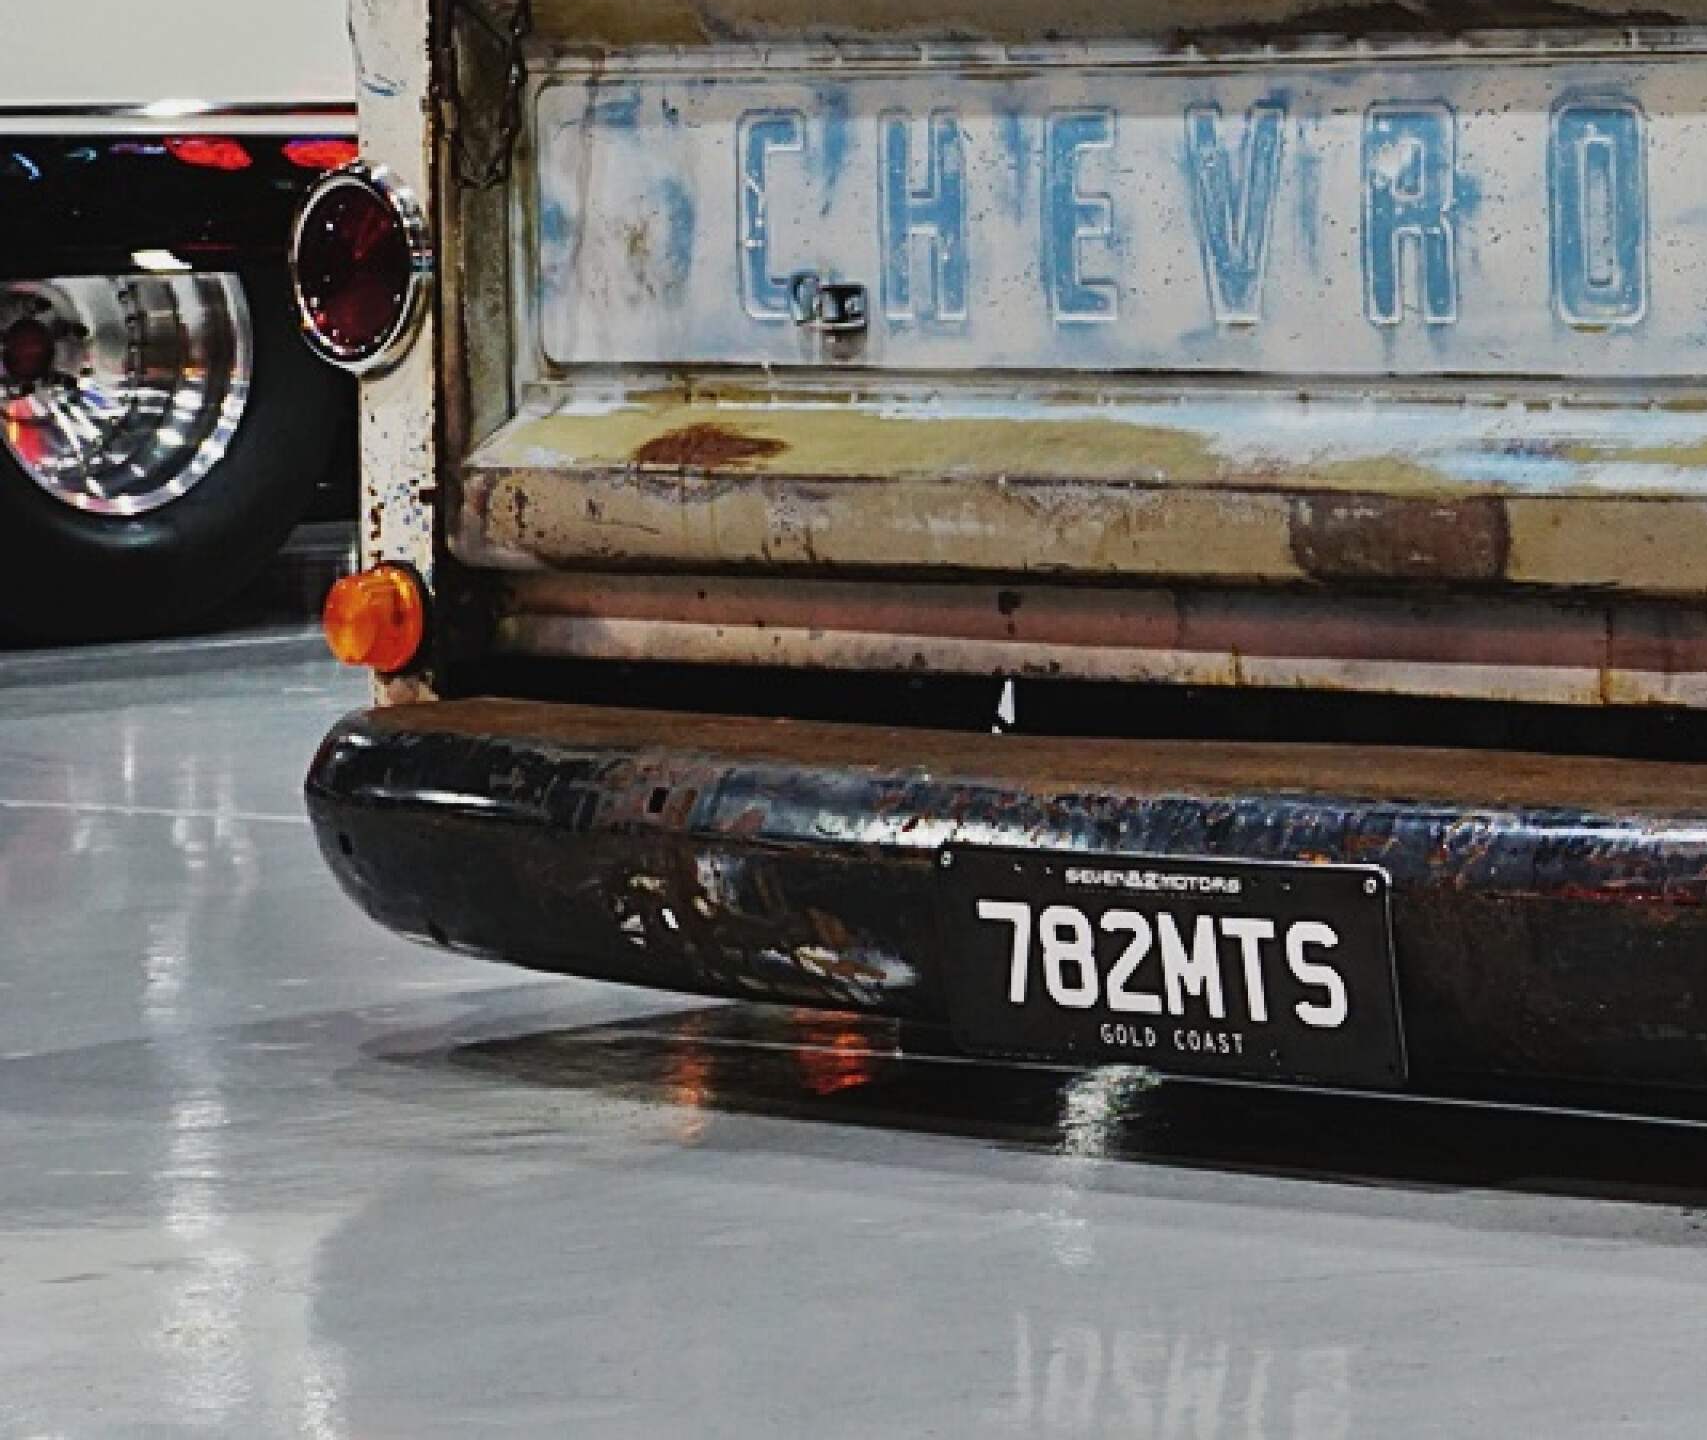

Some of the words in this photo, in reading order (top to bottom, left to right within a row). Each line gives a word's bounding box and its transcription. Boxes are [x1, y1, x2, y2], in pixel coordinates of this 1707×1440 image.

[975, 899, 1349, 1028] 782MTS
[1100, 1022, 1158, 1049] GOLD
[1172, 1028, 1245, 1054] COAST
